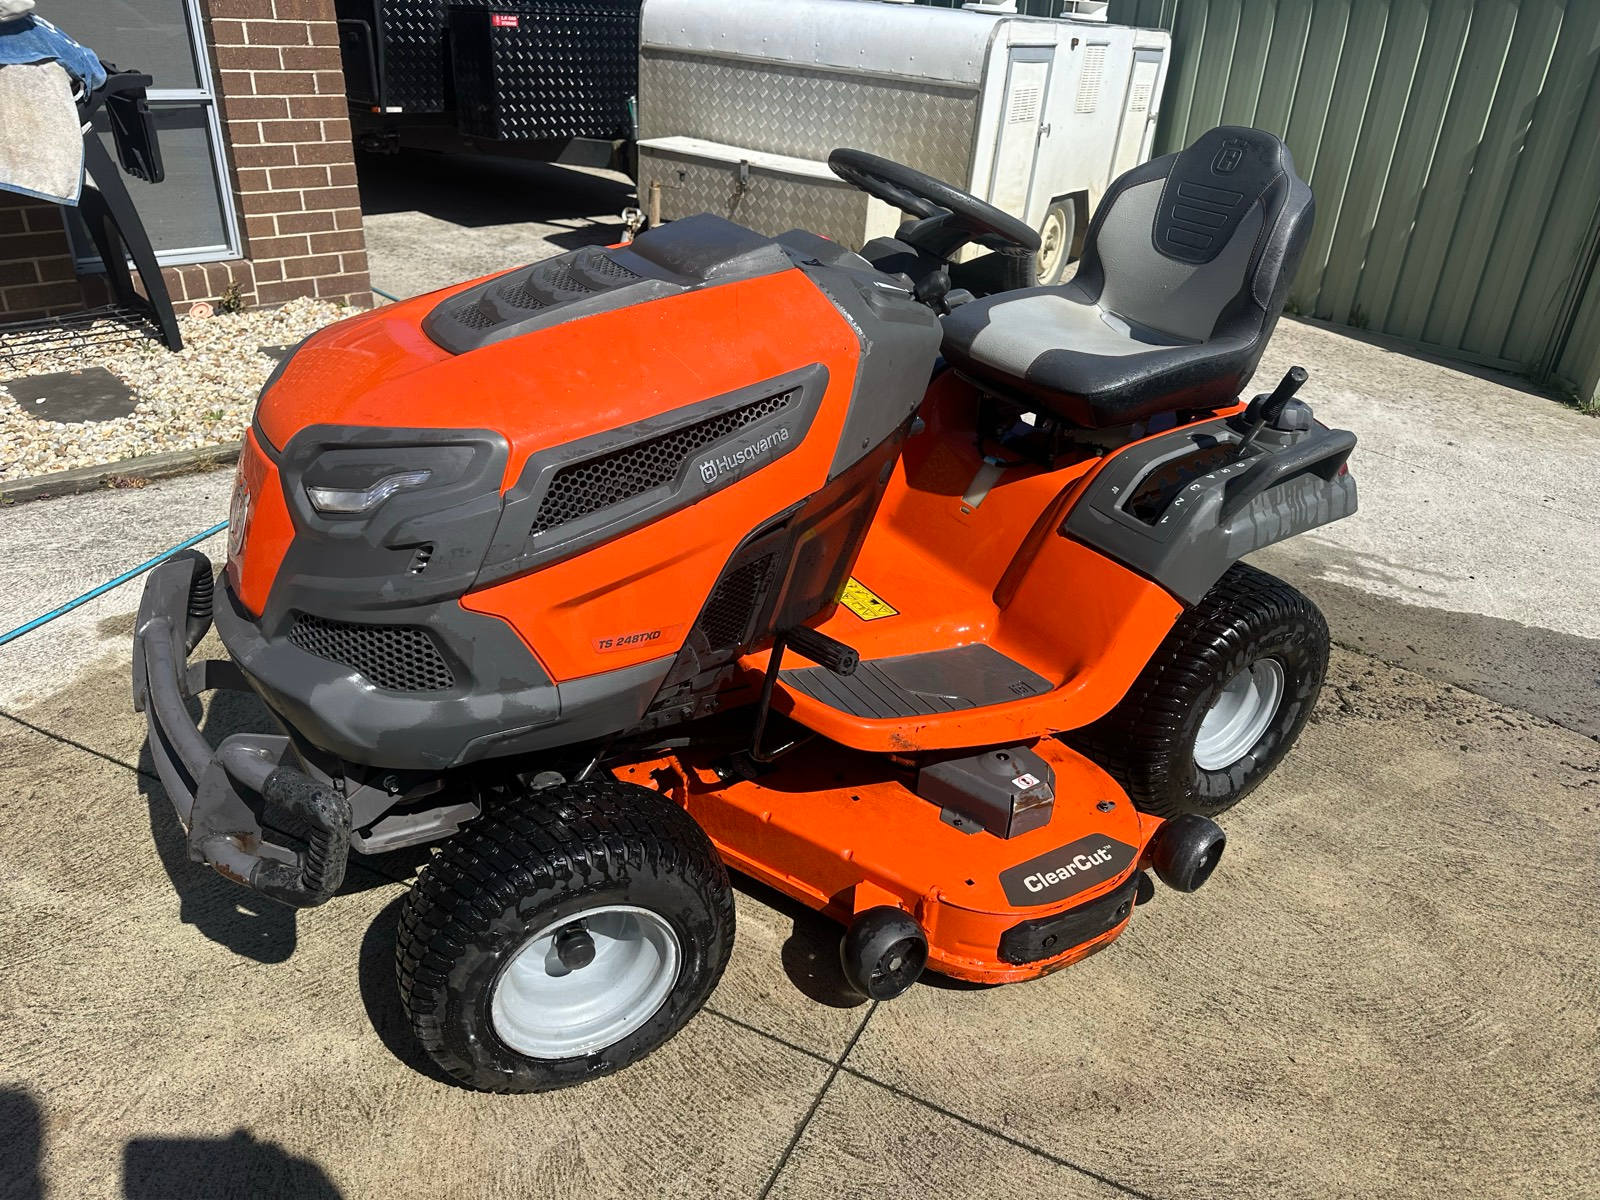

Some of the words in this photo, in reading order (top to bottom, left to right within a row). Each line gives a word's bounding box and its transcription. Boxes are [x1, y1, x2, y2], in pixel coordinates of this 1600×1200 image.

[716, 428, 790, 474] Husqvarna
[1174, 497, 1185, 506] 2
[1160, 516, 1169, 524] 1
[599, 639, 613, 649] TS
[616, 631, 661, 646] 248TXD
